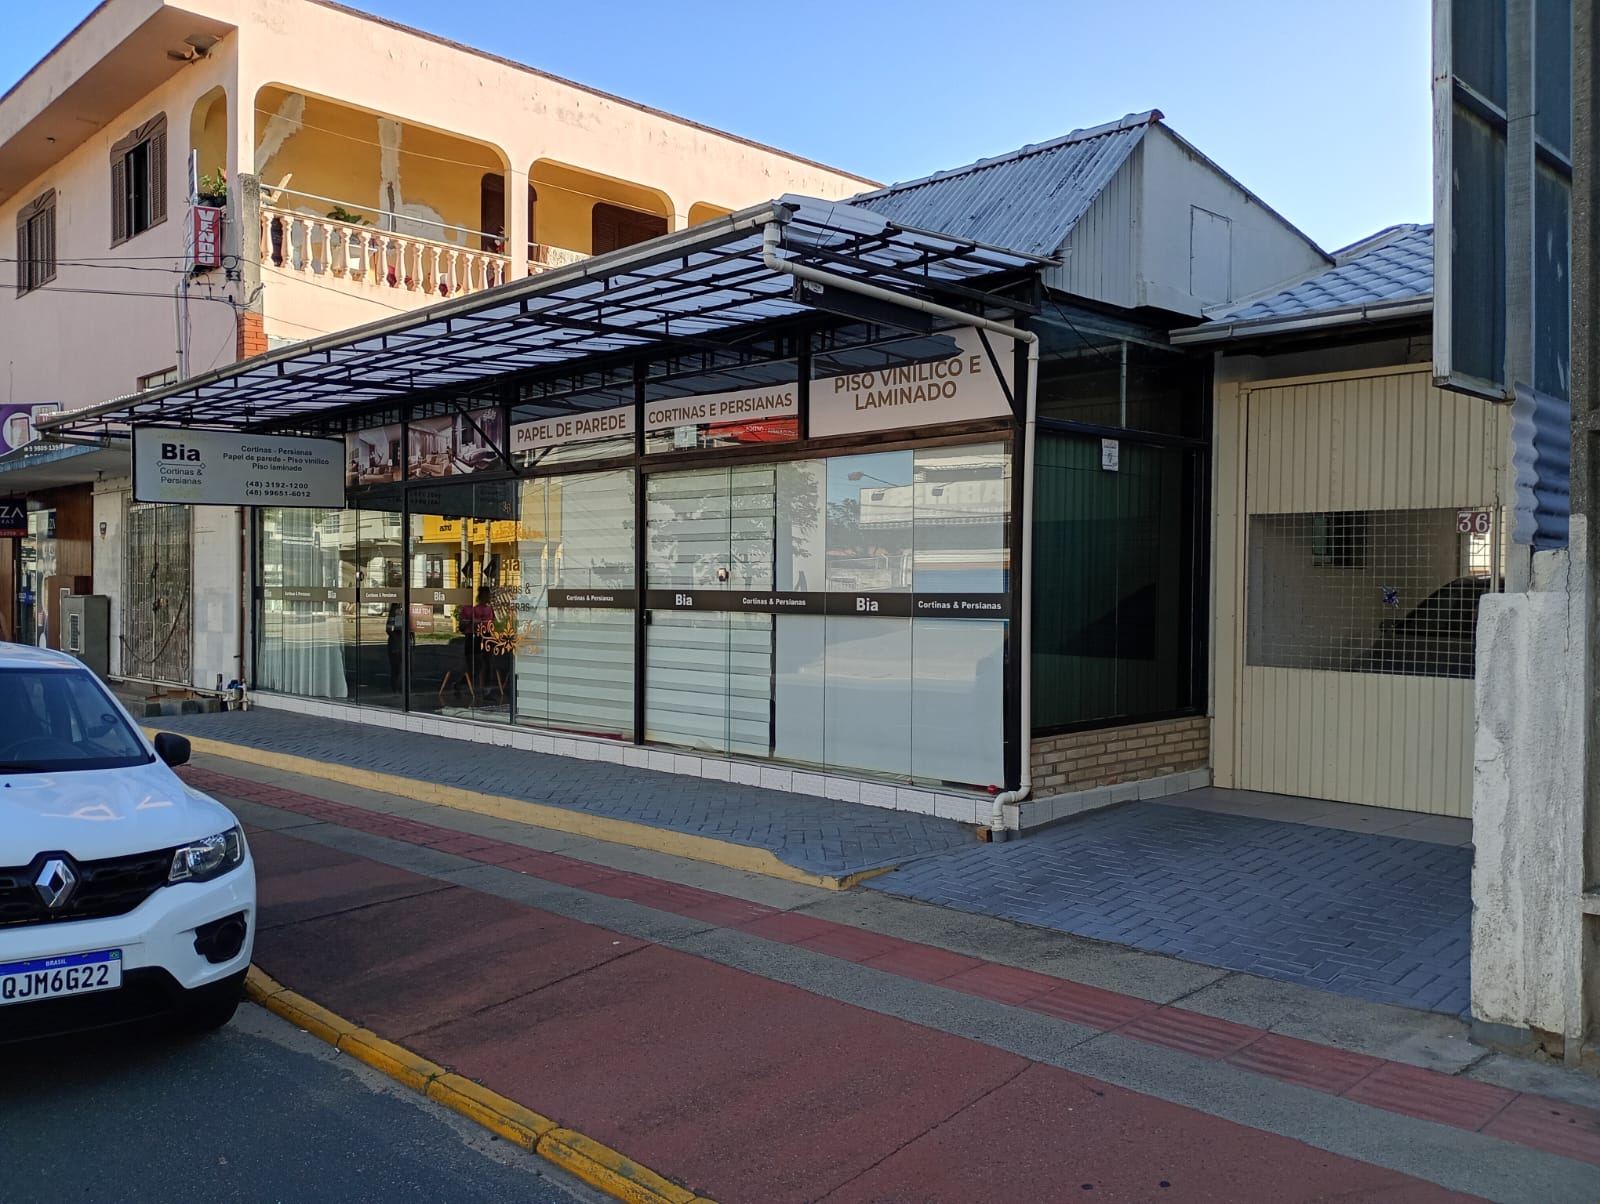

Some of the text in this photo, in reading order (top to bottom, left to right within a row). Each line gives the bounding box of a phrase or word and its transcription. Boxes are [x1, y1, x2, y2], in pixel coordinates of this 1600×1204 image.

[197, 209, 215, 264] VENDO
[834, 372, 875, 394] PISO
[968, 355, 982, 374] E
[855, 380, 957, 411] LAMINADO
[648, 392, 793, 424] CORTINAS E PERSIANAS
[517, 413, 626, 443] PAPEL DE PAREDE
[161, 442, 201, 462] Bia
[241, 445, 272, 454] Cortinas
[278, 447, 313, 456] Persianas
[223, 453, 244, 462] Papel
[256, 455, 281, 464] parede
[159, 467, 203, 476] Cortinas &
[252, 462, 303, 472] Piso laminado
[160, 476, 202, 485] Persianas
[245, 481, 263, 489] (48)
[245, 489, 262, 497] (48)
[1458, 513, 1488, 532] 36
[434, 591, 445, 601] Bia
[591, 594, 614, 602] Persianas
[675, 594, 693, 606] Bia
[742, 597, 767, 605] Cortinas
[775, 598, 806, 606] Persianas
[856, 597, 879, 612] Bia
[918, 600, 1002, 610] Cortinas & Persianas
[2, 964, 109, 1000] QJM6G22
